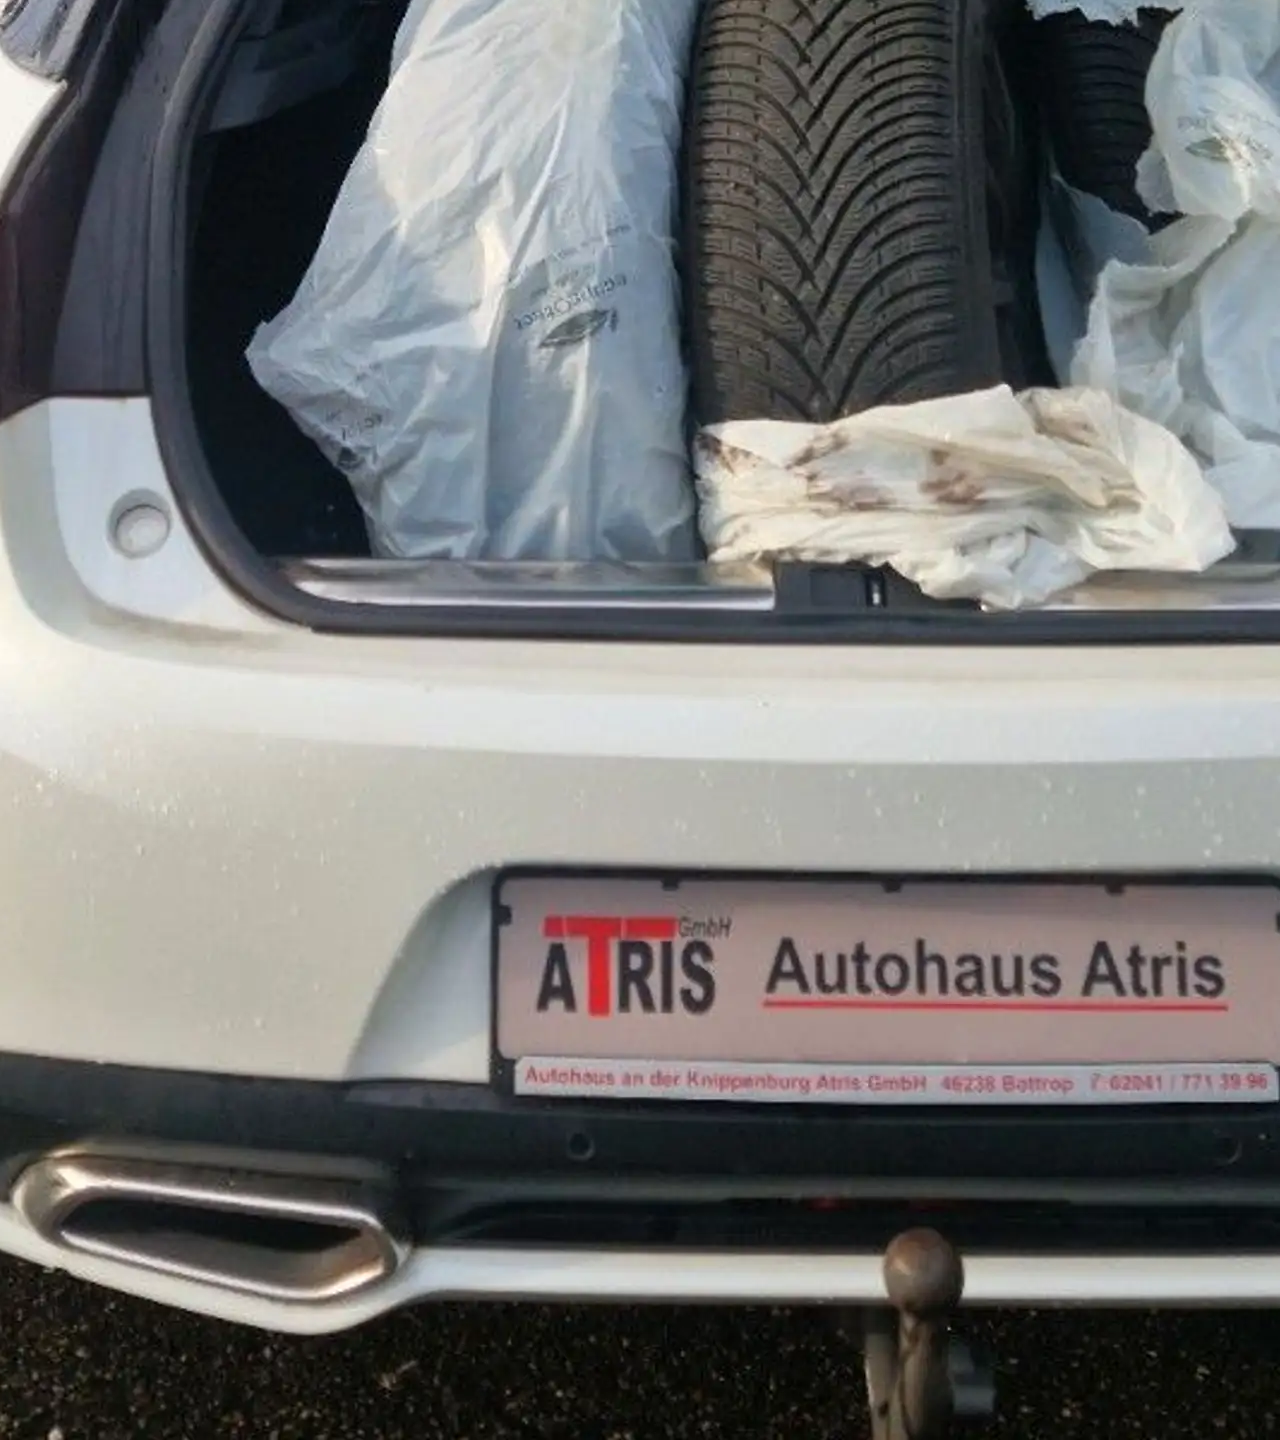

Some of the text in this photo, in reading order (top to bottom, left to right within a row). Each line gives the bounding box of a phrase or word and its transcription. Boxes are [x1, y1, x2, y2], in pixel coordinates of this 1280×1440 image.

[677, 915, 733, 939] GmbH
[535, 915, 717, 1019] ATRIS
[764, 936, 1226, 999] Autohaus Atris
[524, 1065, 616, 1087] Autohaus
[622, 1071, 644, 1087] an
[648, 1070, 680, 1087] der
[687, 1068, 810, 1095] Knippenburg
[816, 1074, 862, 1091] Atris
[869, 1074, 927, 1092] GmbH
[1001, 1074, 1075, 1095] Bottrop
